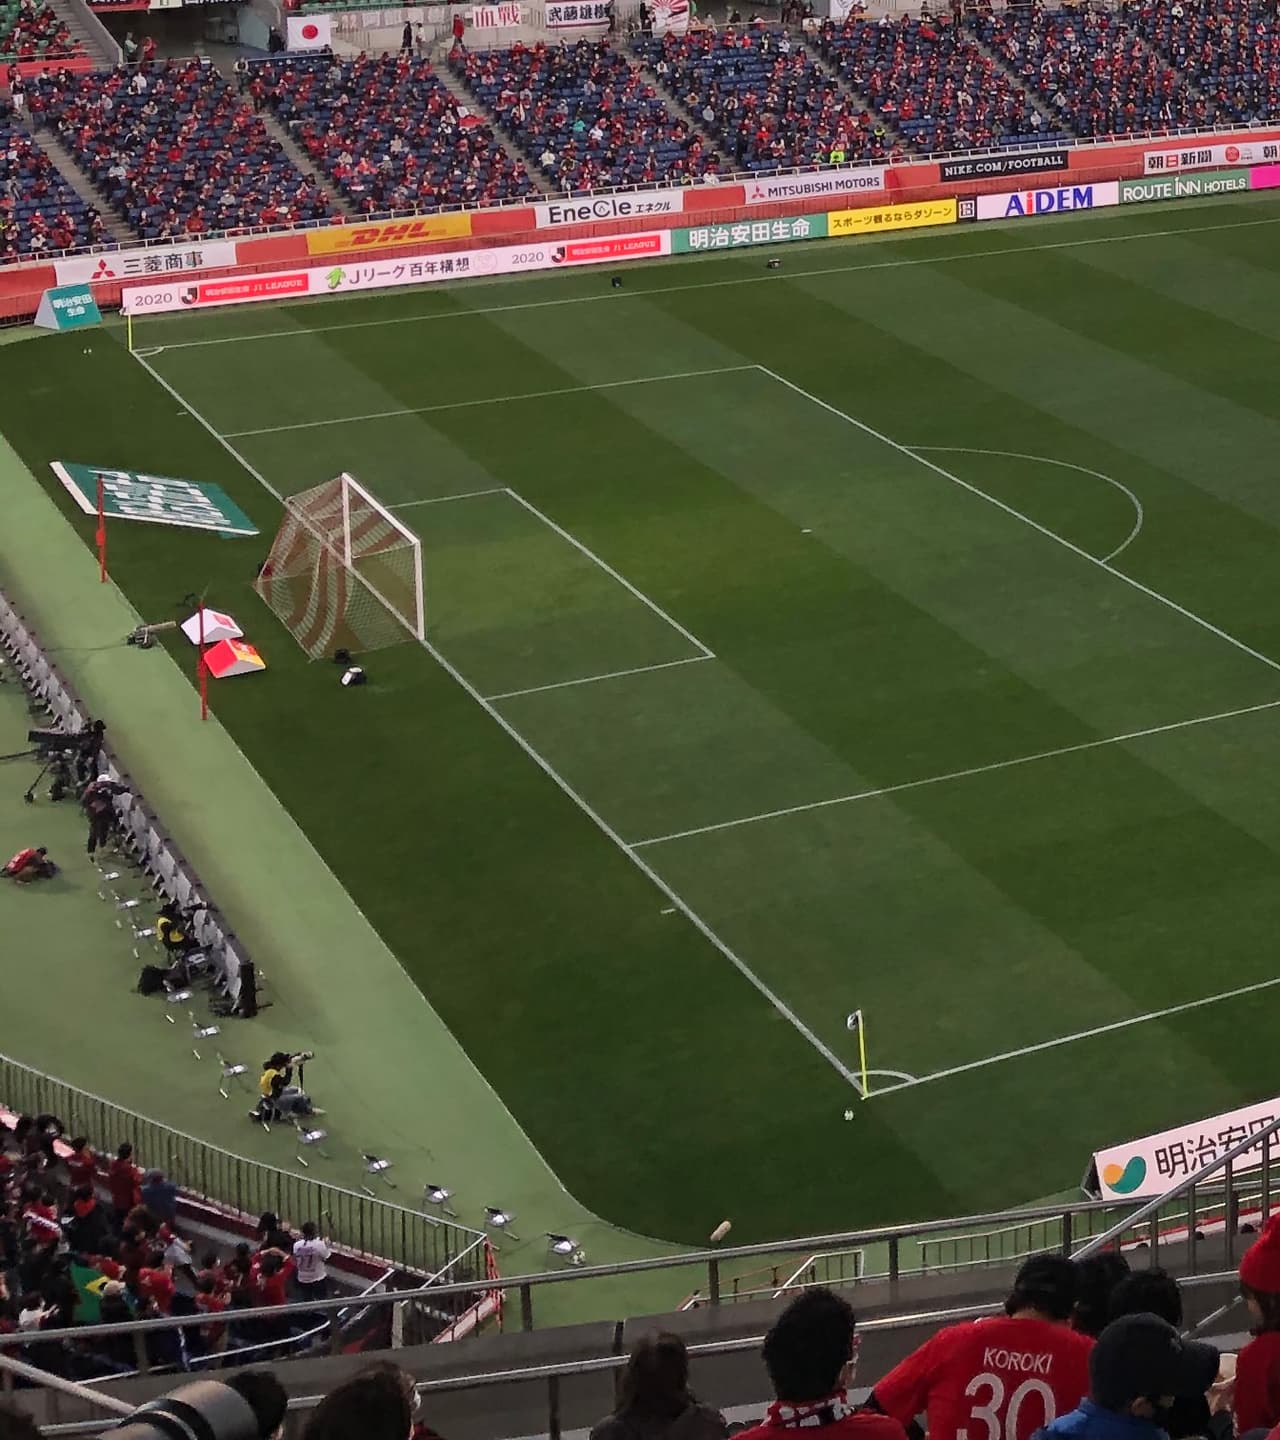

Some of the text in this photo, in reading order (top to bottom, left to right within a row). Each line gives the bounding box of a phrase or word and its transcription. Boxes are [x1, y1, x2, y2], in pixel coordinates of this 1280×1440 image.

[945, 155, 1063, 177] NIKE.COM/FOOTBALL
[1148, 149, 1212, 170] 朝日新聞
[767, 176, 880, 198] MITSUBISHI MOTORS
[1123, 184, 1172, 202] ROUTE
[1204, 176, 1247, 192] HOTELS
[635, 202, 671, 214] エネクル
[833, 207, 953, 230] スポーツ観るならダゾーン
[351, 222, 431, 247] DHL
[689, 218, 810, 249] 明治安田生命
[123, 251, 203, 276] 三菱商事
[349, 257, 470, 285] Jリーグ百年構想
[512, 252, 545, 265] 2020
[135, 279, 304, 307] 2020 LEAGUE
[983, 1347, 1053, 1374] KOROKI
[956, 1372, 1056, 1440] 30
